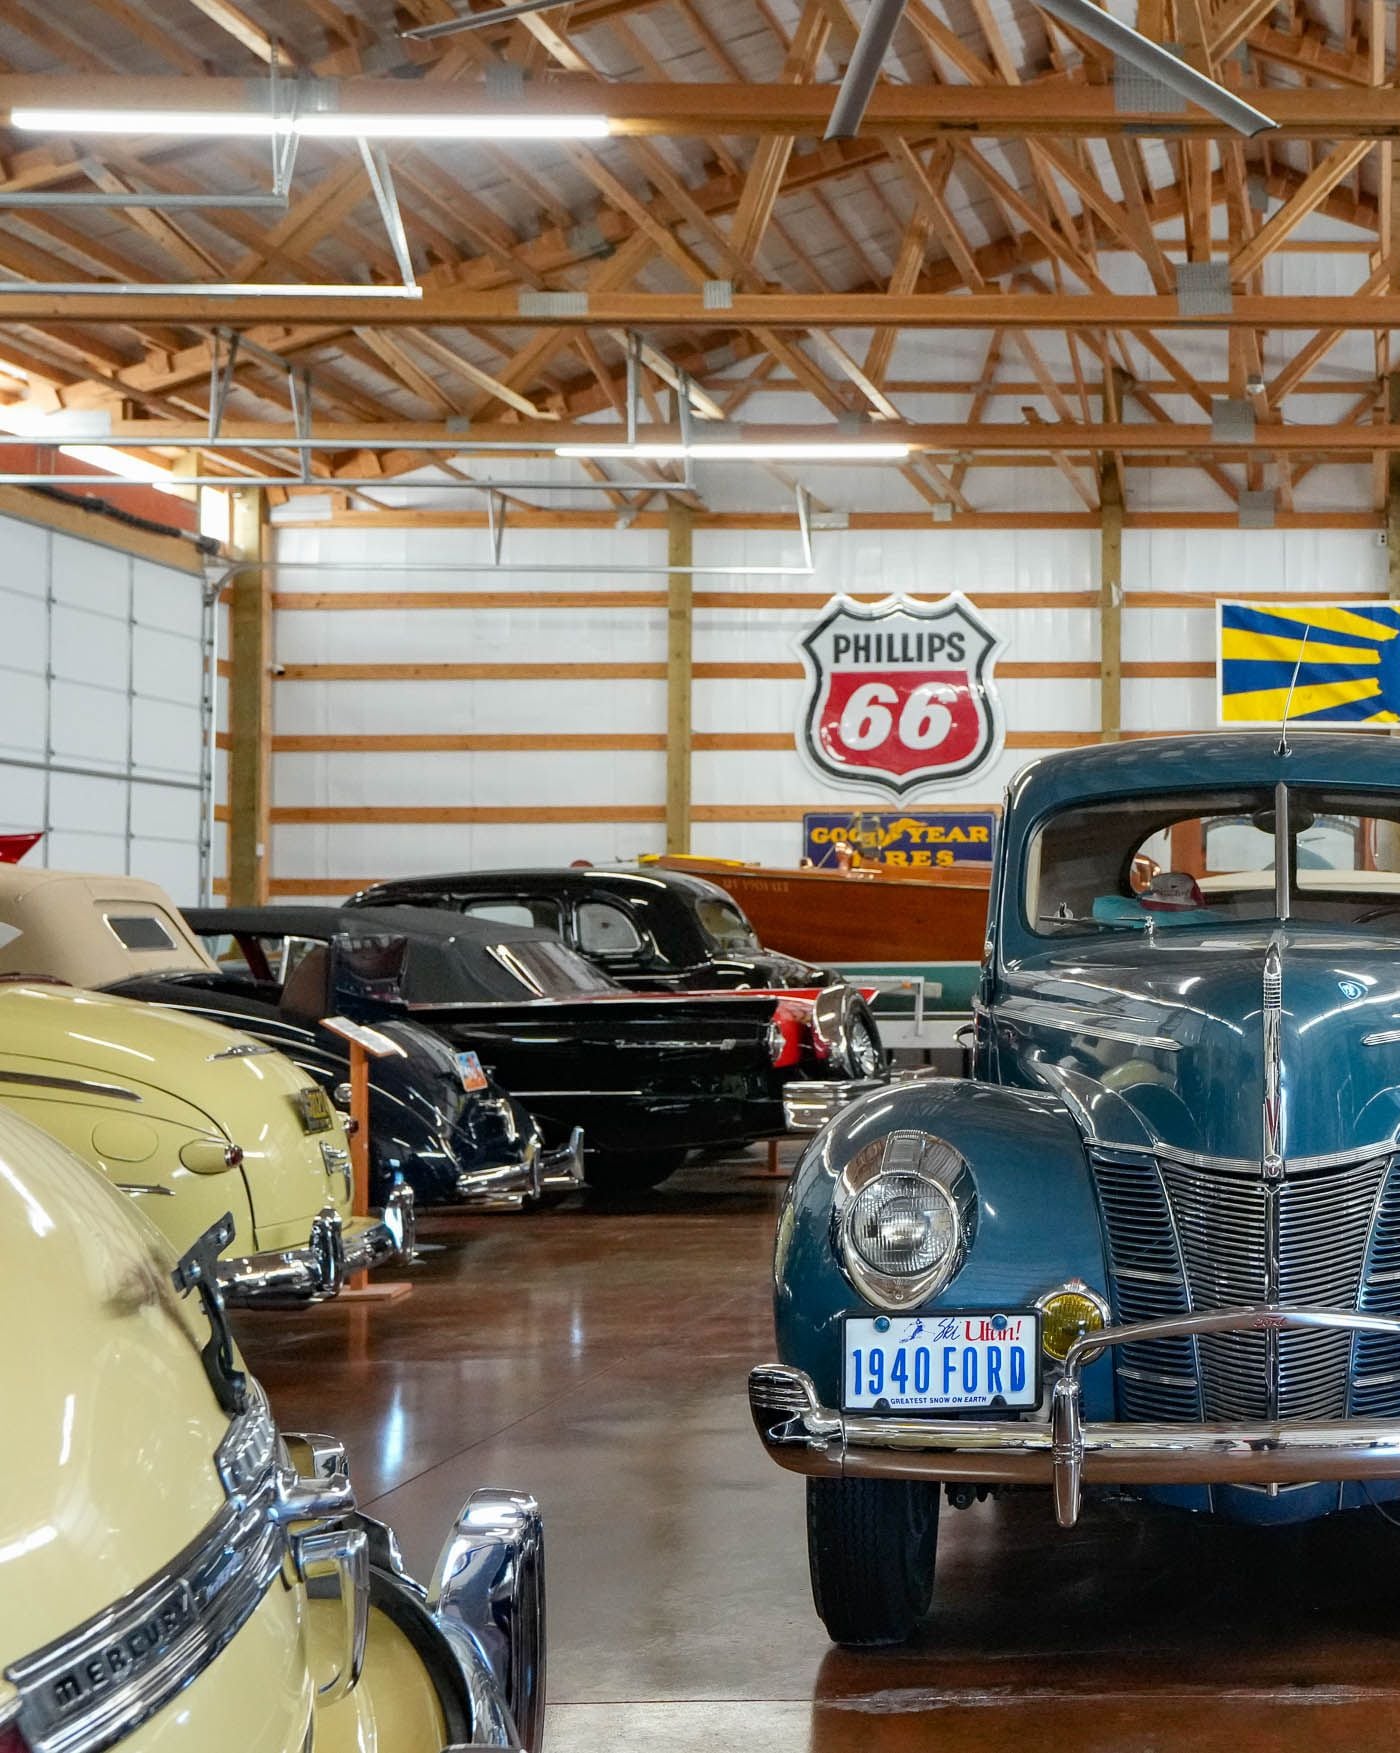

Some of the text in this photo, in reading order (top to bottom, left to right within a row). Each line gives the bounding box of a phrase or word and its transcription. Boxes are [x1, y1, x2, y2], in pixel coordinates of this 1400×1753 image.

[833, 631, 966, 663] PHILLIPS
[839, 682, 958, 751] 66
[933, 1317, 962, 1342] Ski
[852, 1345, 1026, 1395] 1940 FORD
[890, 1397, 927, 1405] GREATEST
[53, 1592, 190, 1705] MERCURY
